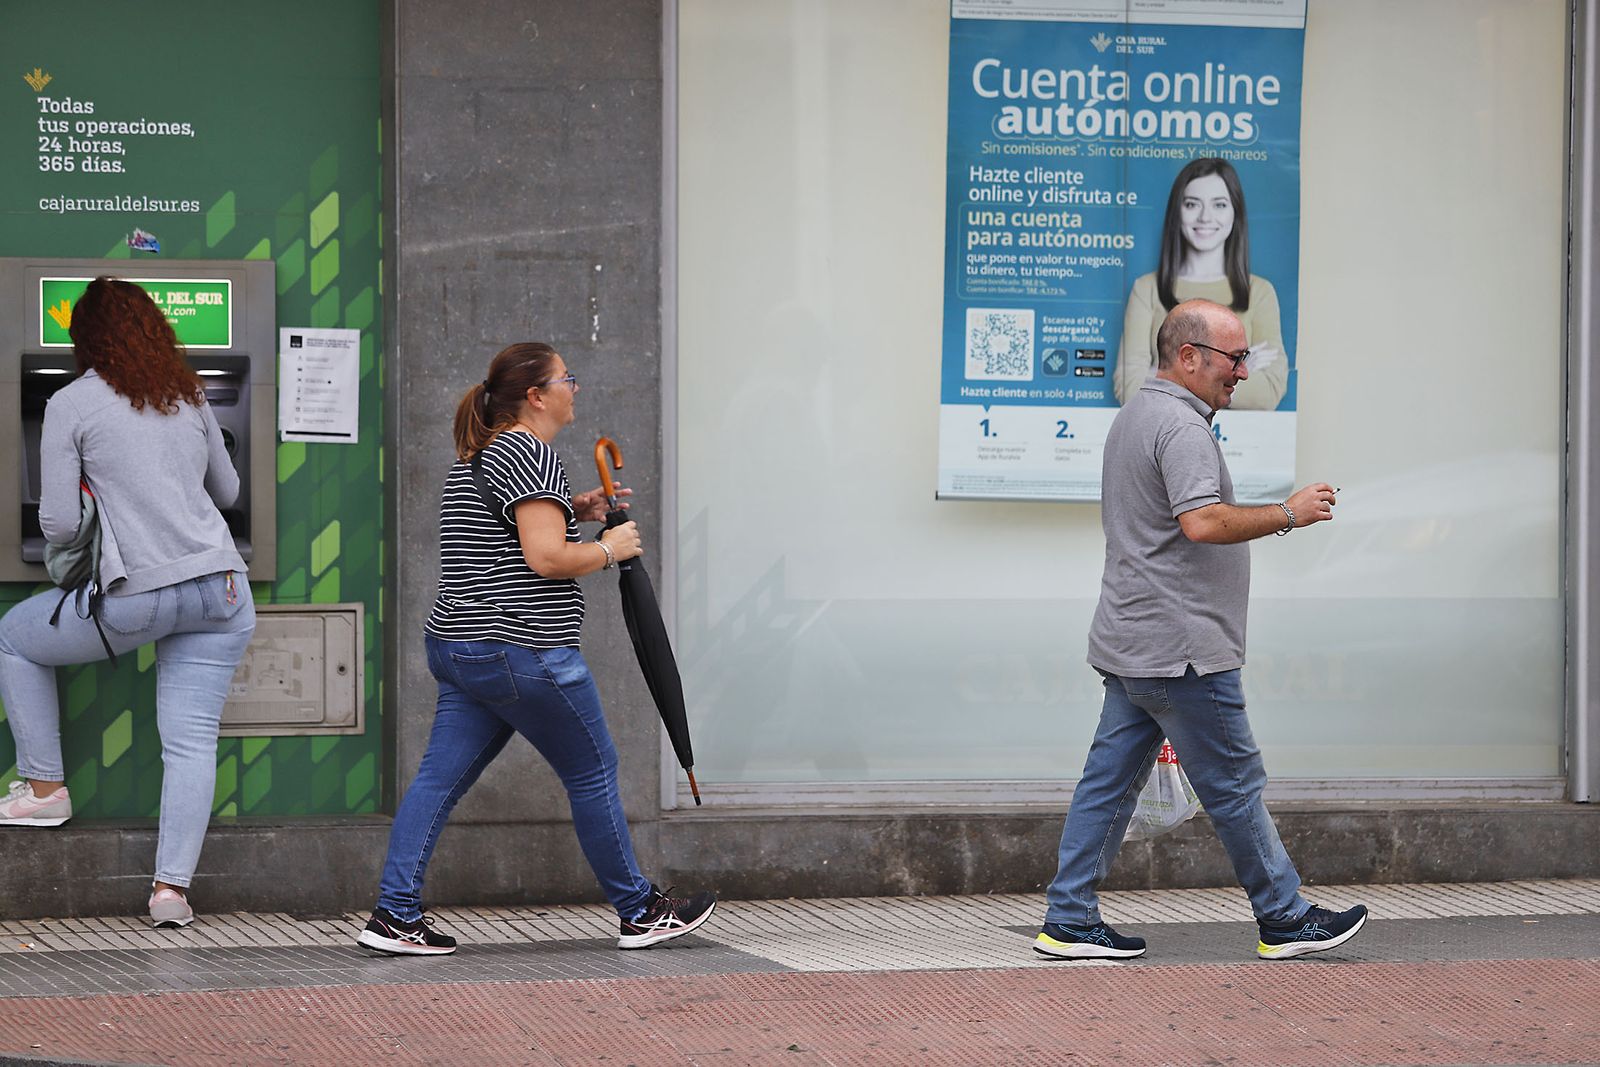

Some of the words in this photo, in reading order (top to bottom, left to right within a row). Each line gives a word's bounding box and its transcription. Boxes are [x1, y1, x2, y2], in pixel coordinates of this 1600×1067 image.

[1138, 36, 1167, 46] RURAL
[1116, 45, 1134, 54] DEL
[1136, 46, 1155, 55] SUR
[972, 58, 1130, 101] Cuenta
[1144, 62, 1281, 106] online
[37, 97, 94, 114] Todas
[38, 117, 69, 133] tus
[76, 118, 195, 137] operaciones,
[998, 99, 1254, 140] autónomos
[39, 137, 62, 152] 24
[68, 137, 126, 156] horas,
[981, 141, 1001, 154] Sin
[1088, 144, 1107, 157] Sin
[1199, 147, 1218, 159] sin
[1221, 149, 1268, 161] mareos
[39, 155, 75, 172] 365
[82, 156, 126, 173] días.
[969, 166, 1020, 183] Hazte
[1024, 167, 1084, 184] cliente
[39, 195, 200, 214] cajaruraldelsur.es
[969, 186, 1024, 203] online
[1027, 189, 1039, 207] y
[1042, 187, 1111, 205] disfruta
[967, 211, 1006, 226] una
[1011, 211, 1082, 228] cuenta
[967, 232, 1013, 250] para
[1018, 229, 1135, 249] autónomos
[966, 254, 987, 265] que
[989, 254, 1017, 266] pone
[1019, 255, 1033, 264] en
[1035, 254, 1063, 265] valor
[1065, 256, 1077, 266] tu
[1079, 256, 1124, 268] negocio,
[966, 265, 978, 275] tu
[980, 265, 1018, 277] dinero,
[1020, 267, 1032, 276] tu
[1035, 267, 1083, 280] tiempo...
[166, 292, 193, 305] DEL
[195, 292, 224, 305] SUR
[1043, 316, 1076, 325] Escanea
[1077, 316, 1085, 325] el
[1086, 316, 1098, 326] QR
[1099, 319, 1105, 328] y
[1091, 326, 1100, 334] la
[1059, 335, 1070, 343] de
[960, 387, 990, 398] Hazte
[992, 386, 1028, 398] cliente
[1029, 389, 1043, 398] en
[1044, 387, 1065, 399] solo
[1066, 388, 1074, 399] 4
[1075, 389, 1105, 400] pasos
[979, 419, 998, 437] 1.
[1055, 420, 1075, 439] 2.
